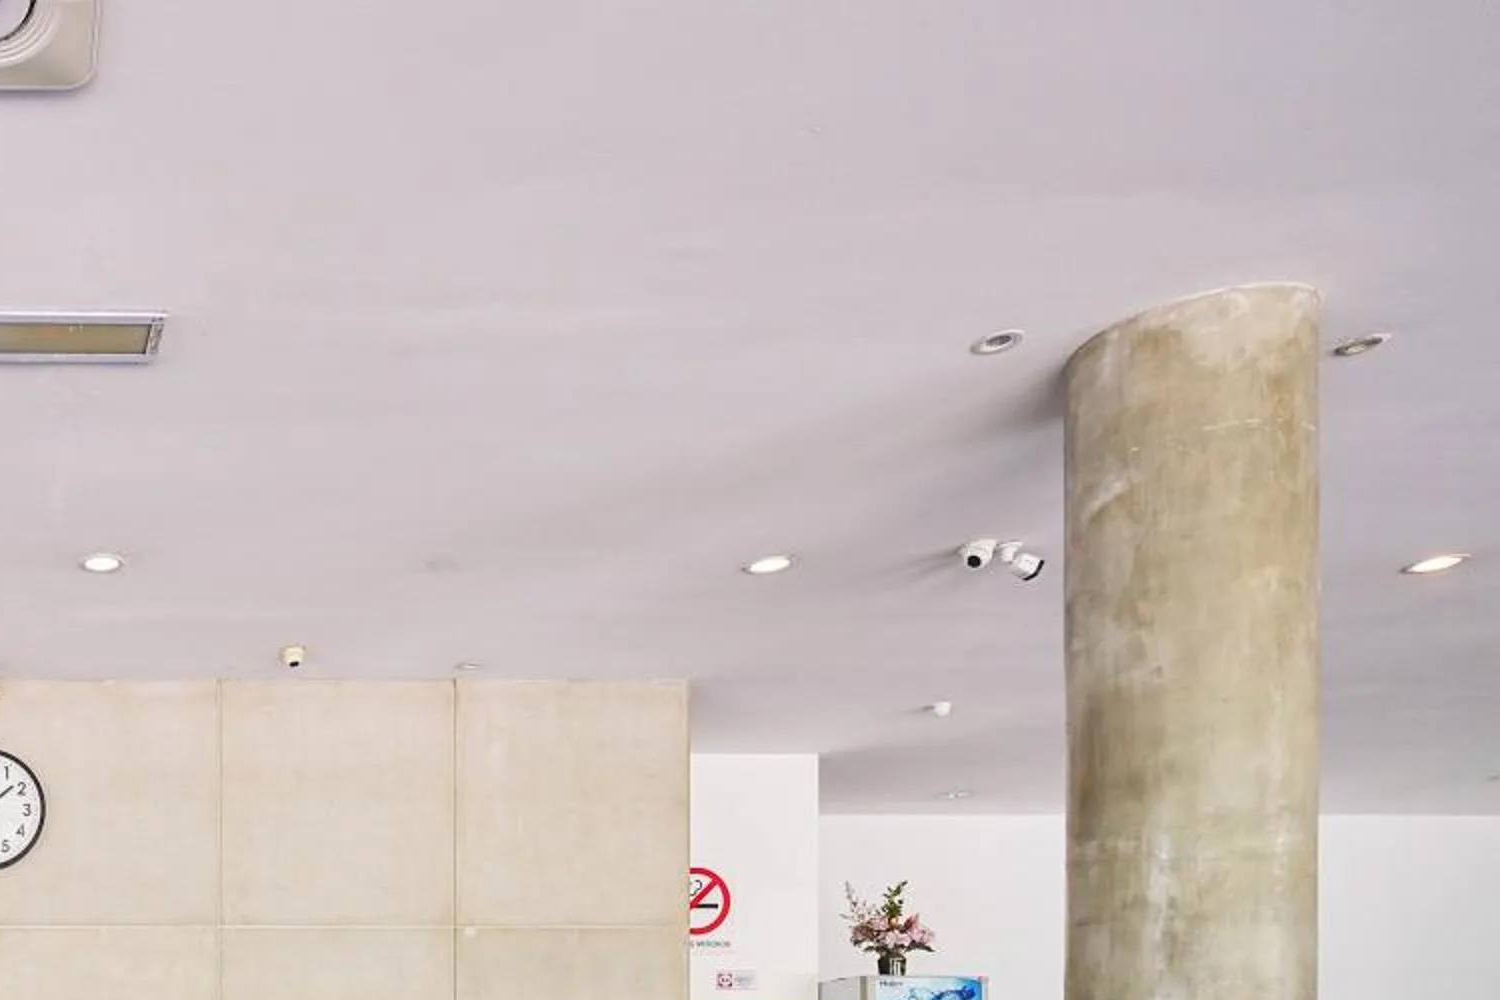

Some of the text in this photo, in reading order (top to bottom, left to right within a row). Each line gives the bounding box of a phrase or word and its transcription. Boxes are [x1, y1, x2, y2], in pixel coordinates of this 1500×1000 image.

[3, 765, 10, 780] 1
[17, 782, 26, 796] 2
[22, 803, 31, 817] 3
[16, 825, 25, 837] 4
[1, 839, 11, 852] 5
